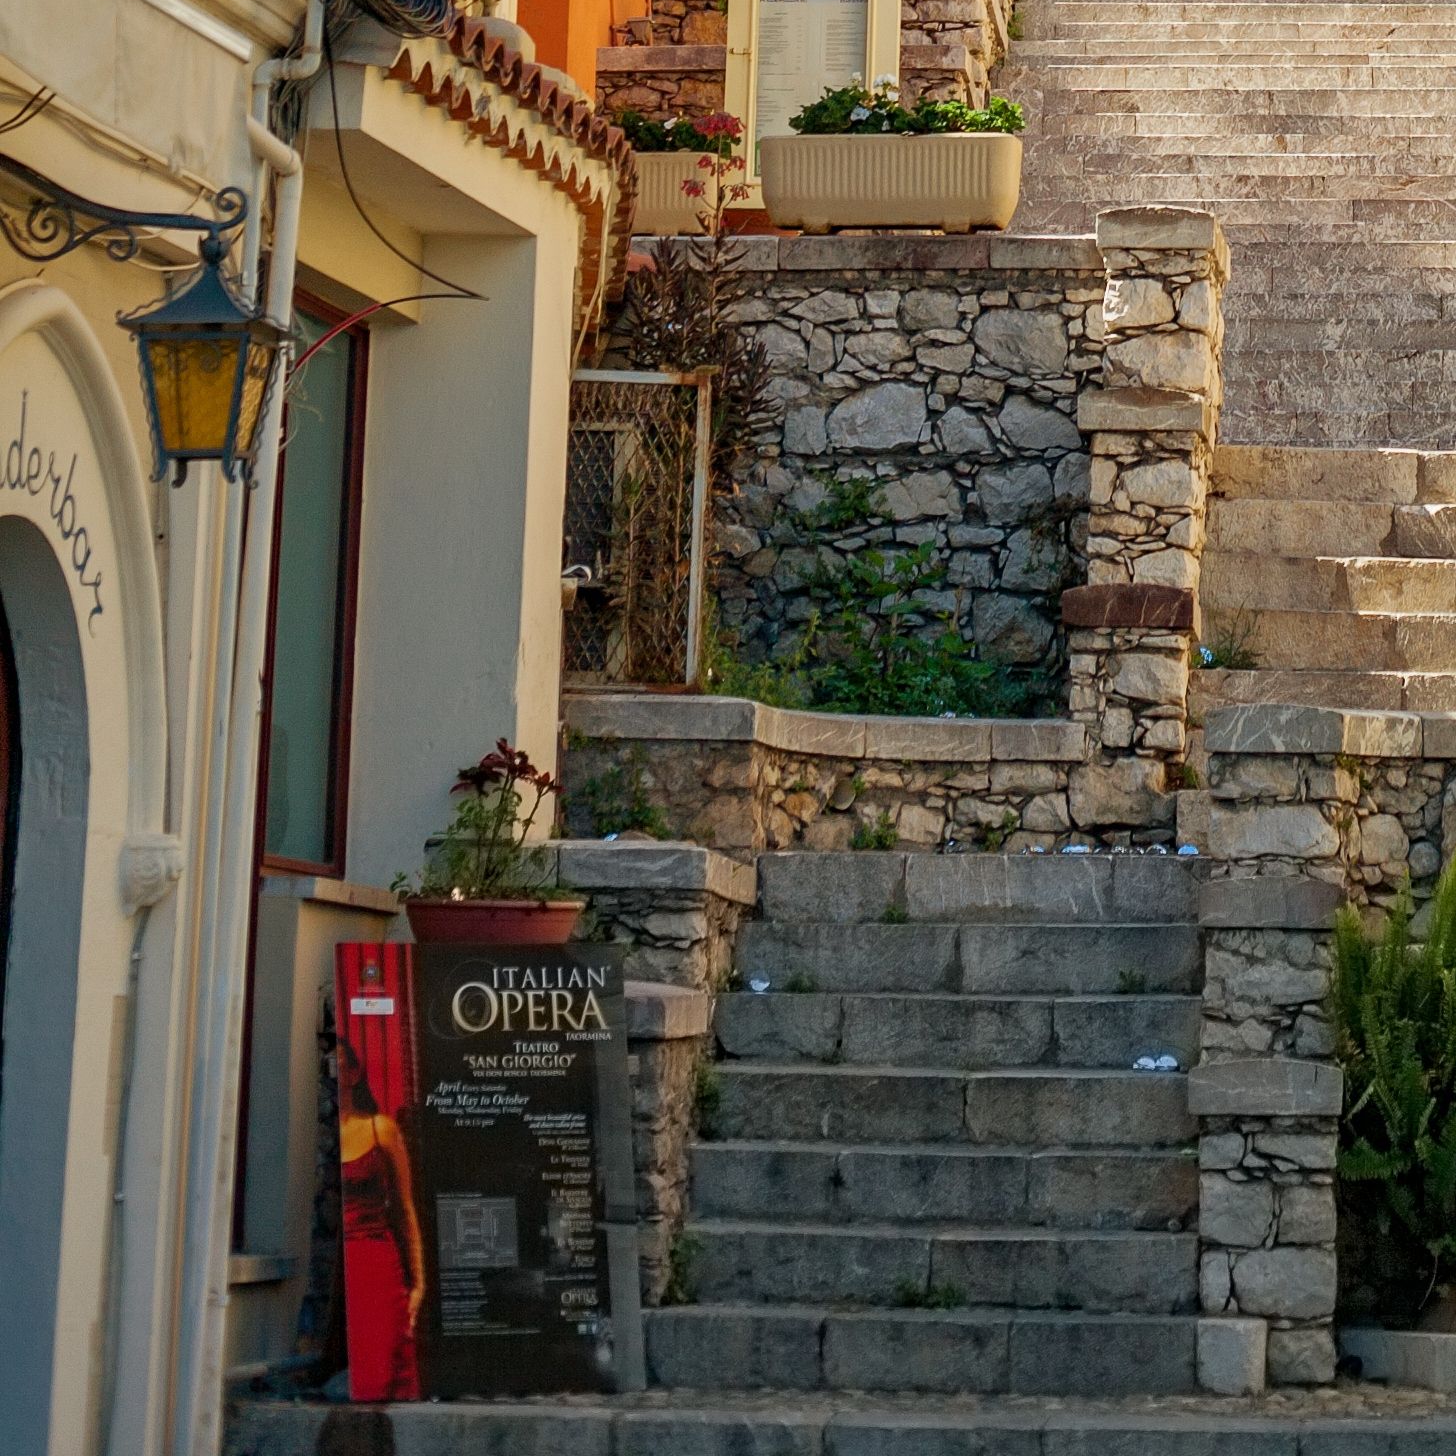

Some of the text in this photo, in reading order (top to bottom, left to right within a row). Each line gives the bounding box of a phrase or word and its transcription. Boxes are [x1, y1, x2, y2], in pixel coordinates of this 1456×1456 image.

[0, 388, 103, 638] derbar
[492, 967, 606, 989] ITALIAN
[451, 981, 610, 1032] OPERA
[565, 1032, 612, 1041] TAORMINA
[513, 1041, 559, 1053] TEATRO
[435, 1080, 462, 1095] April
[426, 1094, 530, 1106] From May to October
